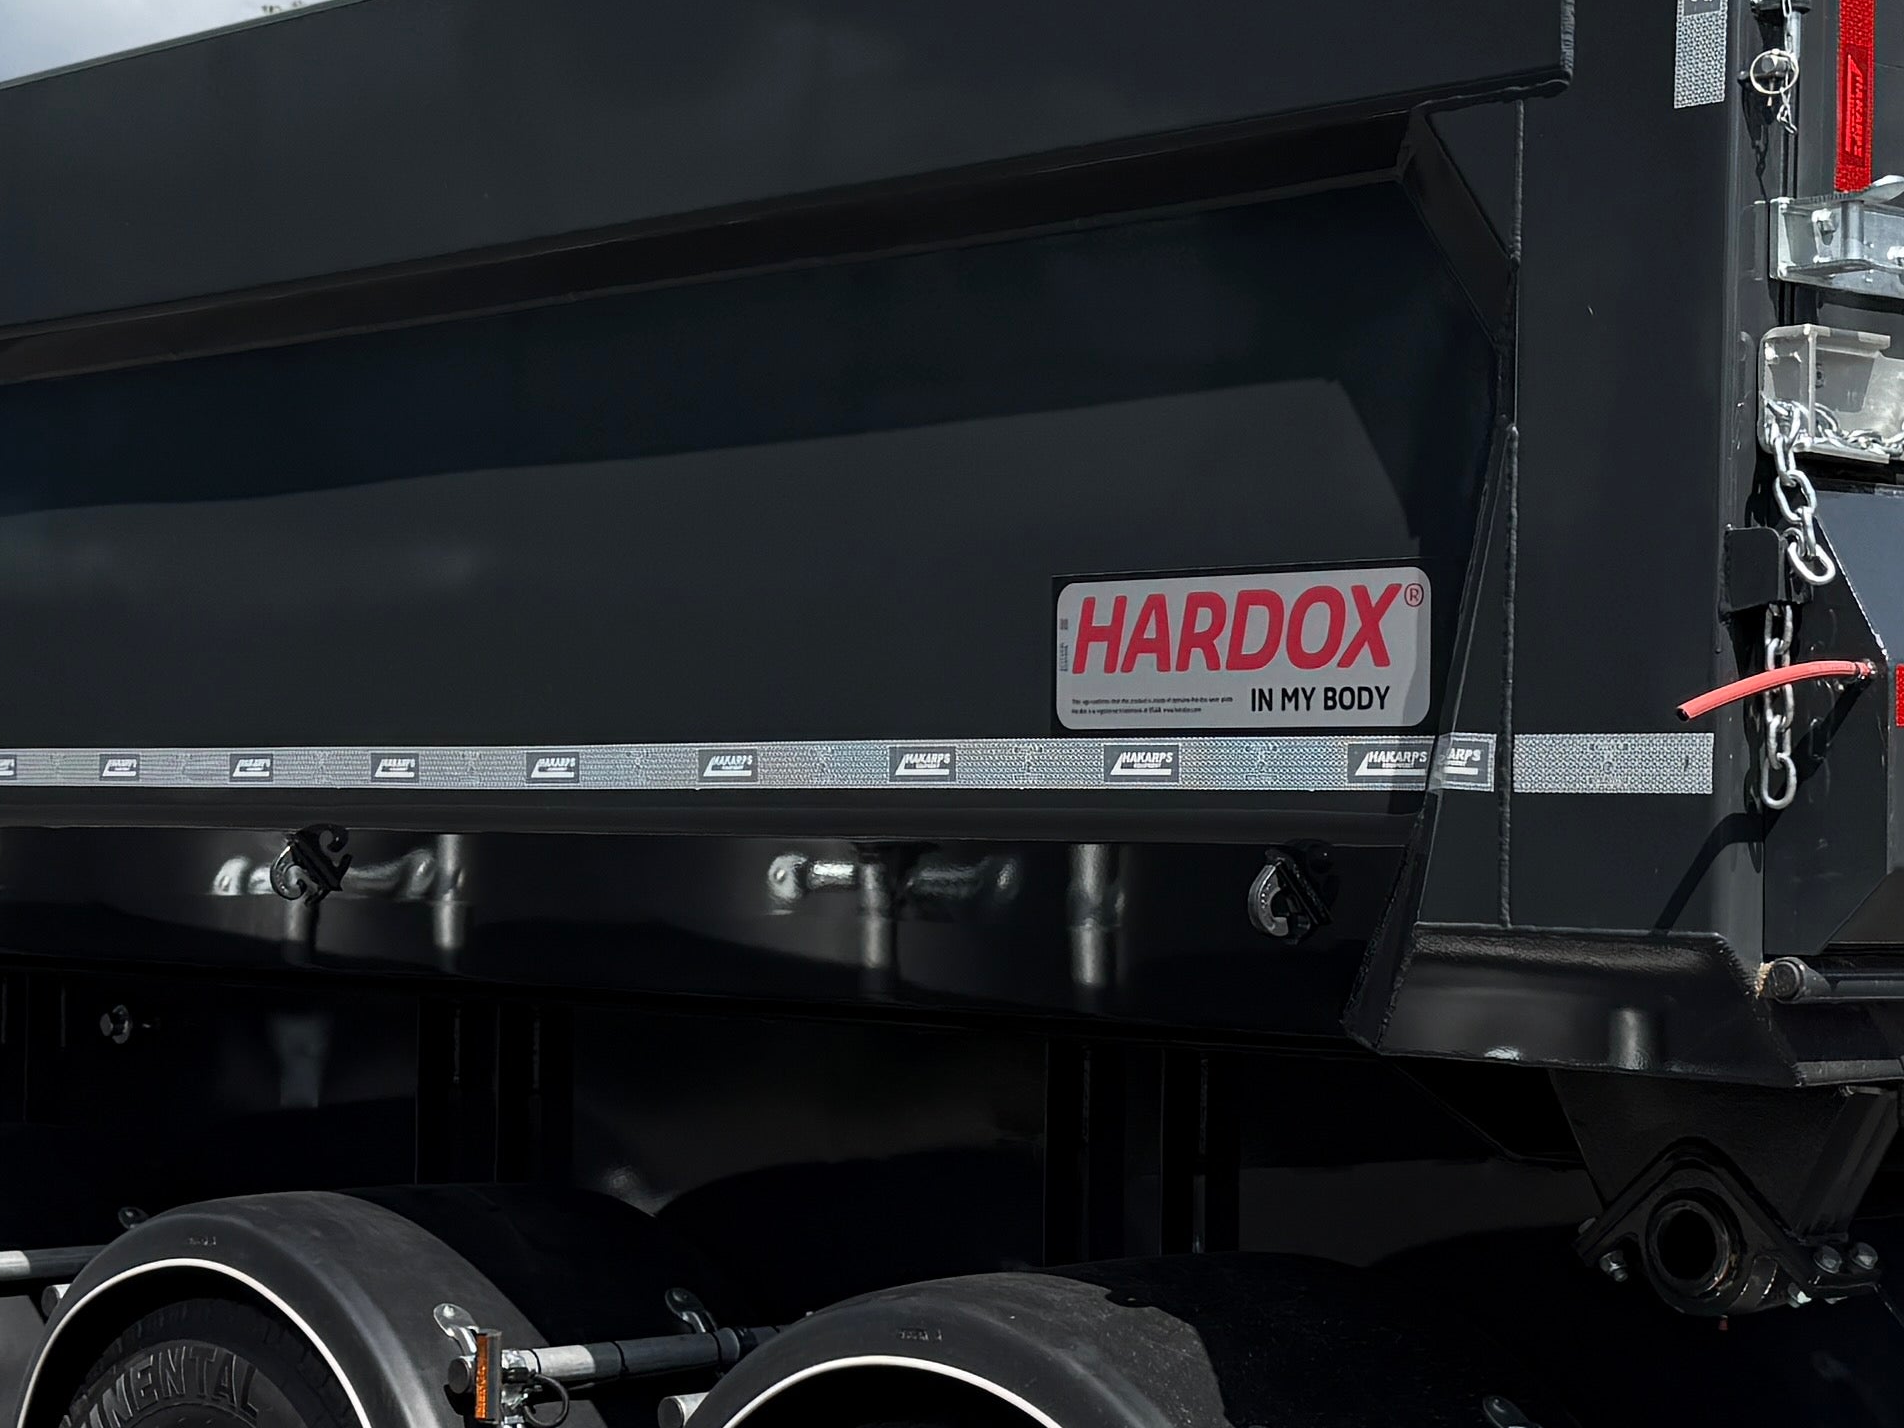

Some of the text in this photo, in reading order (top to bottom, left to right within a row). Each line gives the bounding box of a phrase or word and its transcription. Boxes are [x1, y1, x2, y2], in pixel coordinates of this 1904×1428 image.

[1251, 685, 1391, 713] IN MY BODY
[1121, 751, 1173, 763] HAKARPS
[1368, 750, 1427, 763] HAKARPS
